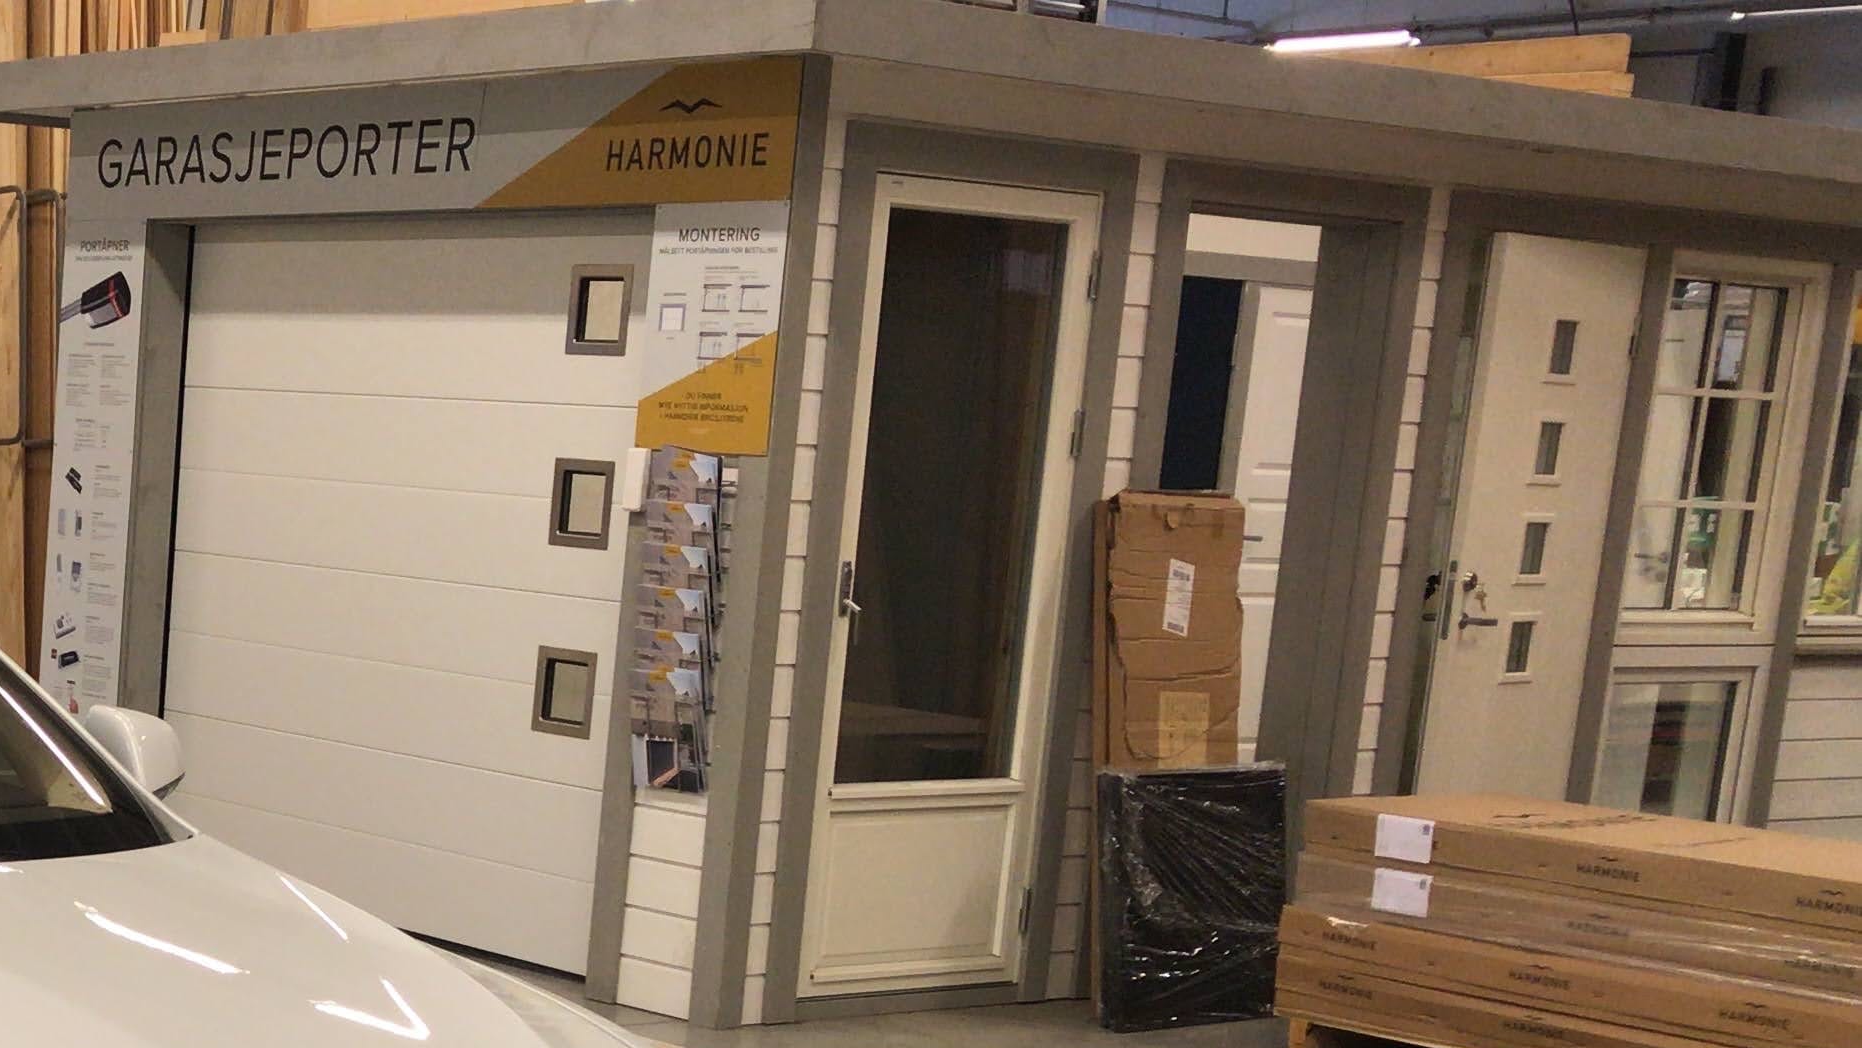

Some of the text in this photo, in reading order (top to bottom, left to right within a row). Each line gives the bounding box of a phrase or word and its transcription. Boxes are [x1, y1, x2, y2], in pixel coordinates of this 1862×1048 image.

[97, 116, 477, 189] GARASJEPORTER
[605, 132, 770, 172] HARMONIE
[678, 227, 761, 243] MONTERING
[1575, 862, 1640, 883] HARMONIE
